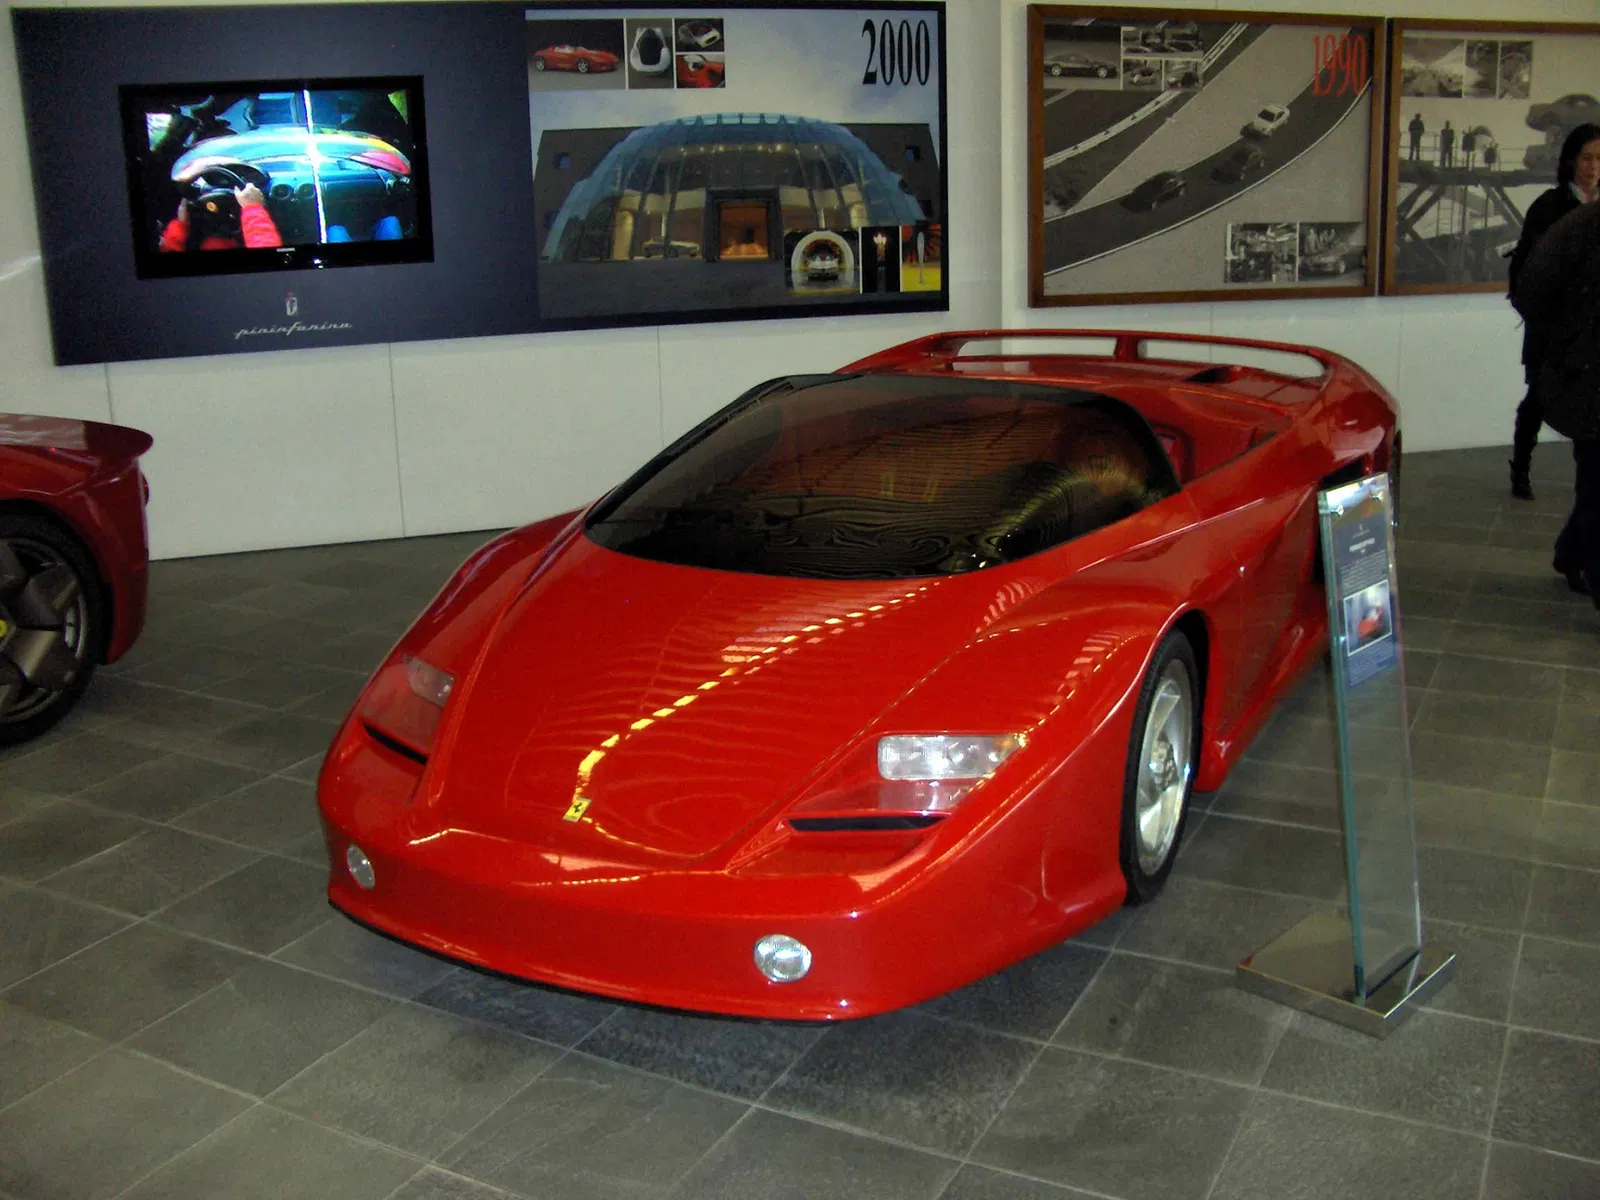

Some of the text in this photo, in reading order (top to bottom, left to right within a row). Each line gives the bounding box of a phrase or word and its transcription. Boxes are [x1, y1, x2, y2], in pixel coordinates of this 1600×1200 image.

[861, 18, 931, 86] 2000
[1312, 33, 1367, 97] 1990
[235, 321, 352, 339] pininfarina
